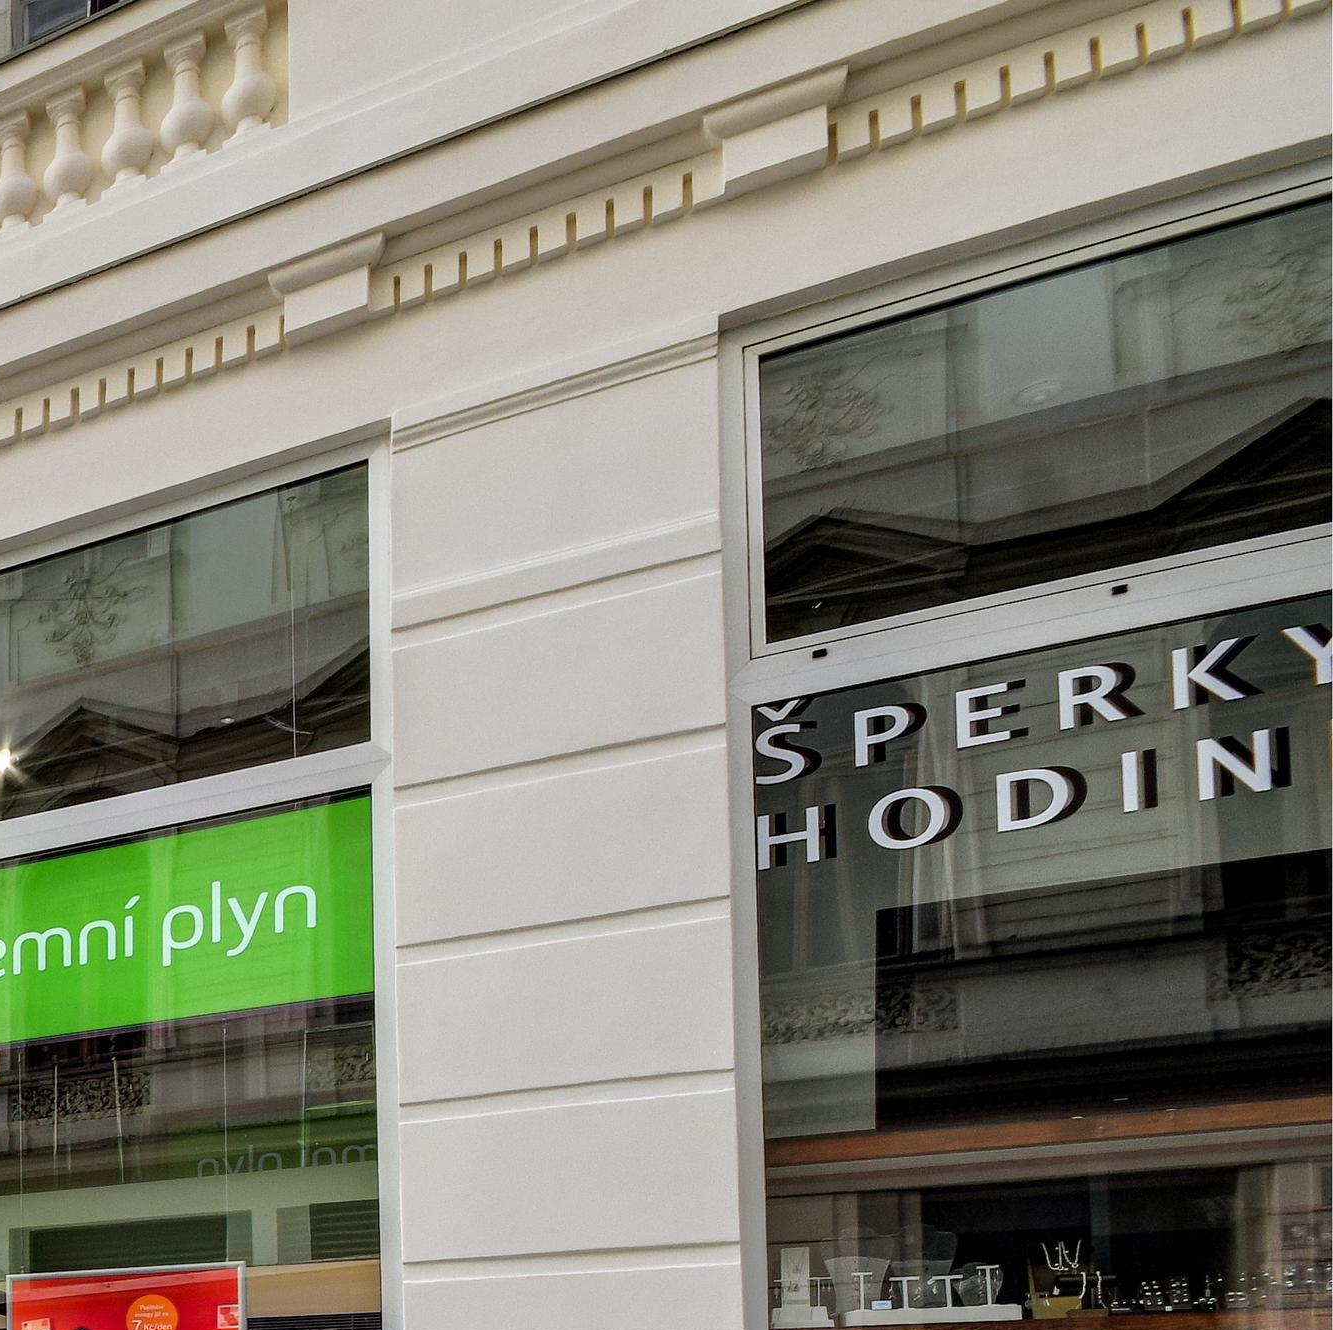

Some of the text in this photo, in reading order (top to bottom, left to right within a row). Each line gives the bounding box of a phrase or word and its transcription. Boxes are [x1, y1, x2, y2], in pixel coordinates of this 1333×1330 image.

[755, 624, 1331, 785] ŠPERKY
[756, 720, 1331, 871] HODIN
[162, 880, 317, 967] plyn
[143, 1323, 173, 1330] Kč/den
